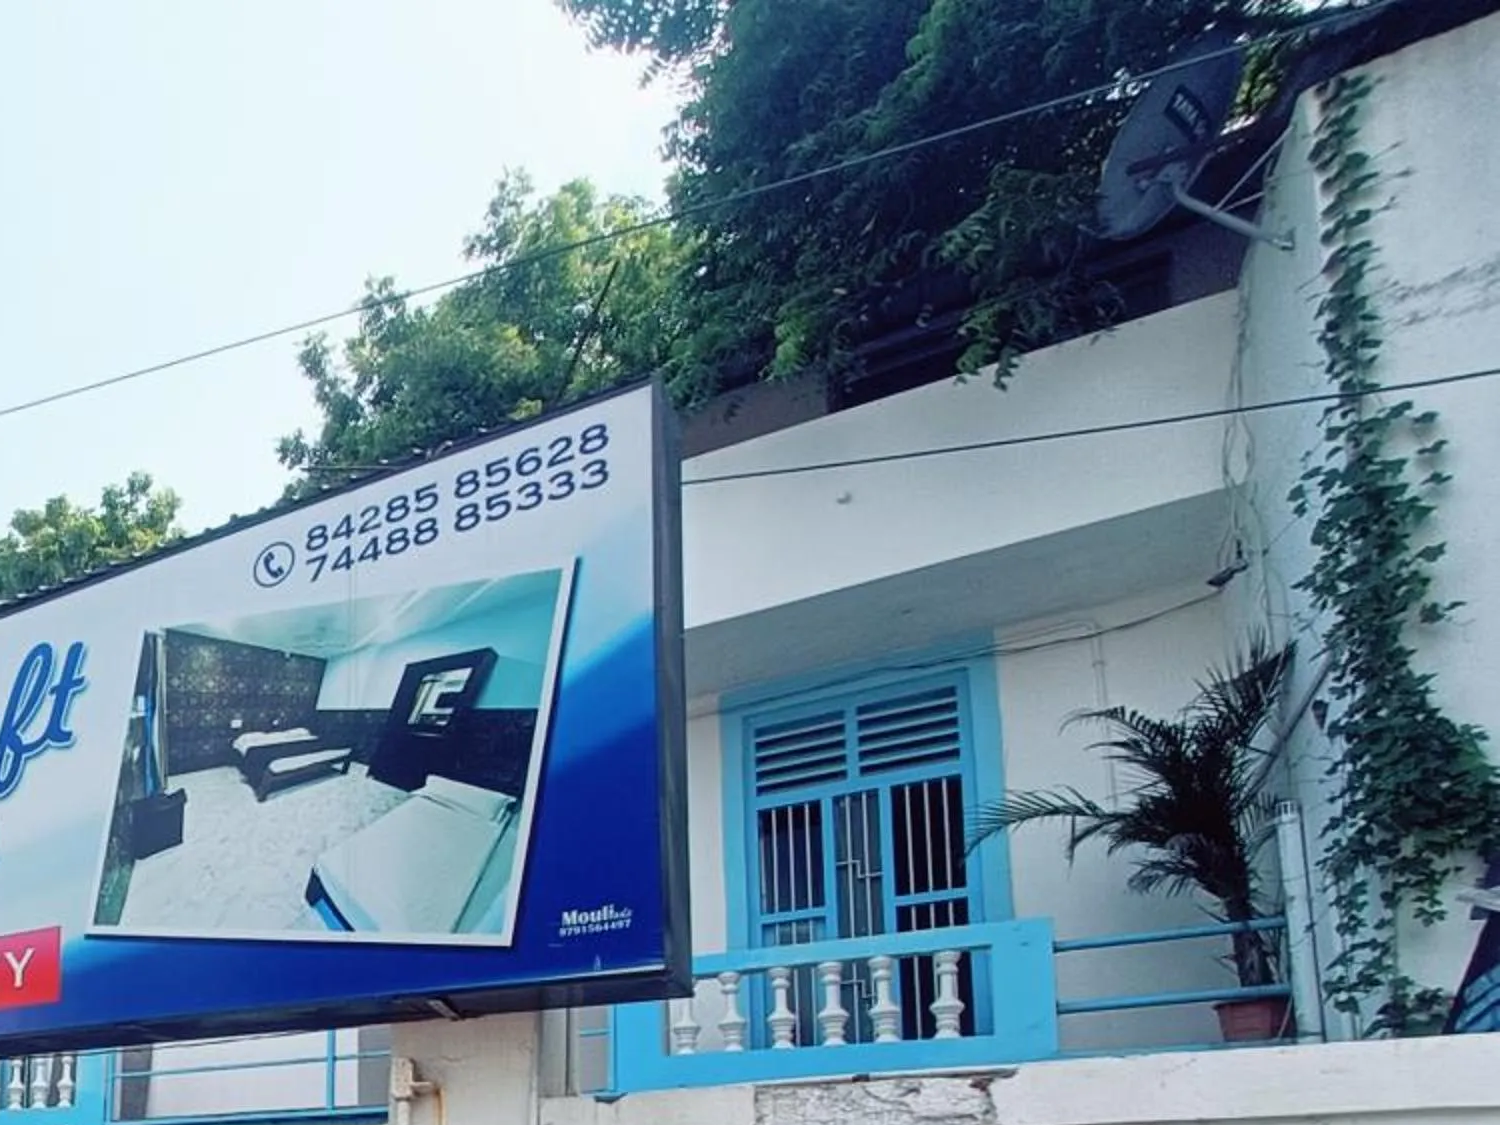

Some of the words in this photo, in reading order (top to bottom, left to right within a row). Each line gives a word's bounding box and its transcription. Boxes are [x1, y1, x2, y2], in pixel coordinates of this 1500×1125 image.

[305, 483, 439, 551] 84285
[453, 424, 610, 500] 85628
[305, 517, 439, 583] 74488
[453, 458, 610, 533] 85333
